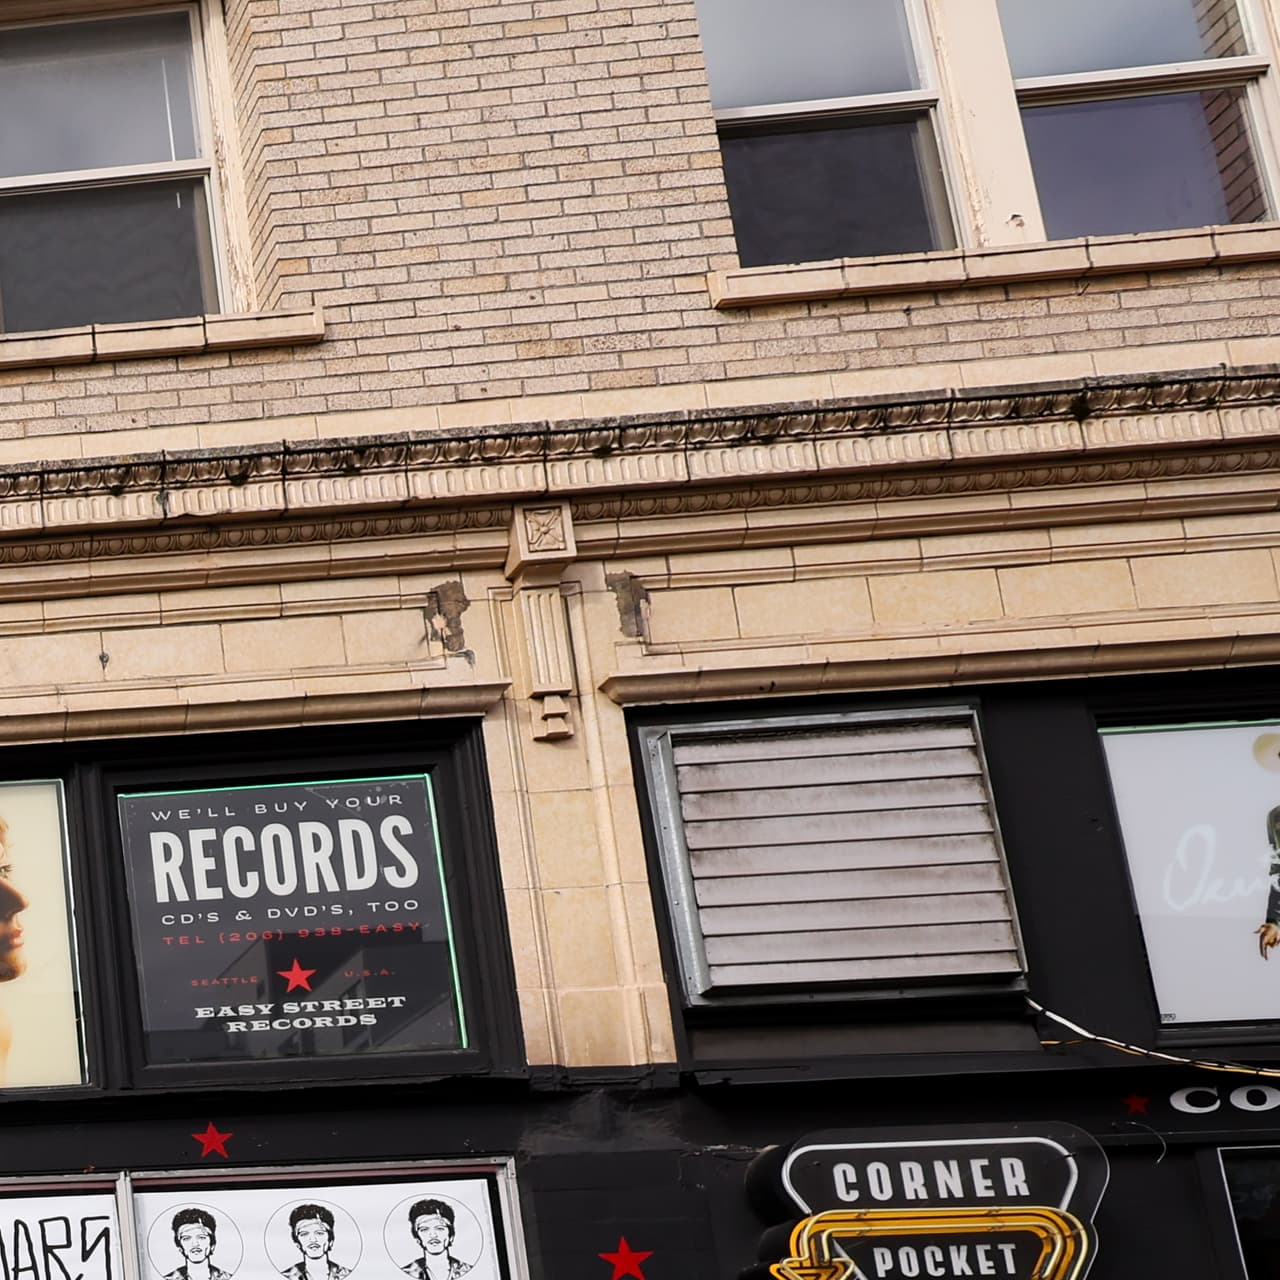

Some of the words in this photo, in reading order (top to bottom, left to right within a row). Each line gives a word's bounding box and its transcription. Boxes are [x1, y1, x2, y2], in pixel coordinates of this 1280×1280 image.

[151, 806, 237, 822] WE'LL
[254, 801, 308, 815] BUY
[326, 794, 404, 809] YOUR
[149, 815, 420, 903] RECORDS
[161, 910, 221, 926] CD'S
[235, 909, 253, 922] &
[367, 899, 420, 914] TOO
[162, 935, 206, 946] TEL
[218, 928, 285, 945] (206)
[190, 976, 259, 988] SEATTLE
[194, 1002, 275, 1019] EASY
[282, 995, 407, 1014] STREET
[225, 1013, 378, 1033] RECORDS
[832, 1156, 1031, 1202] CORNER
[873, 1243, 1018, 1279] POCKET
